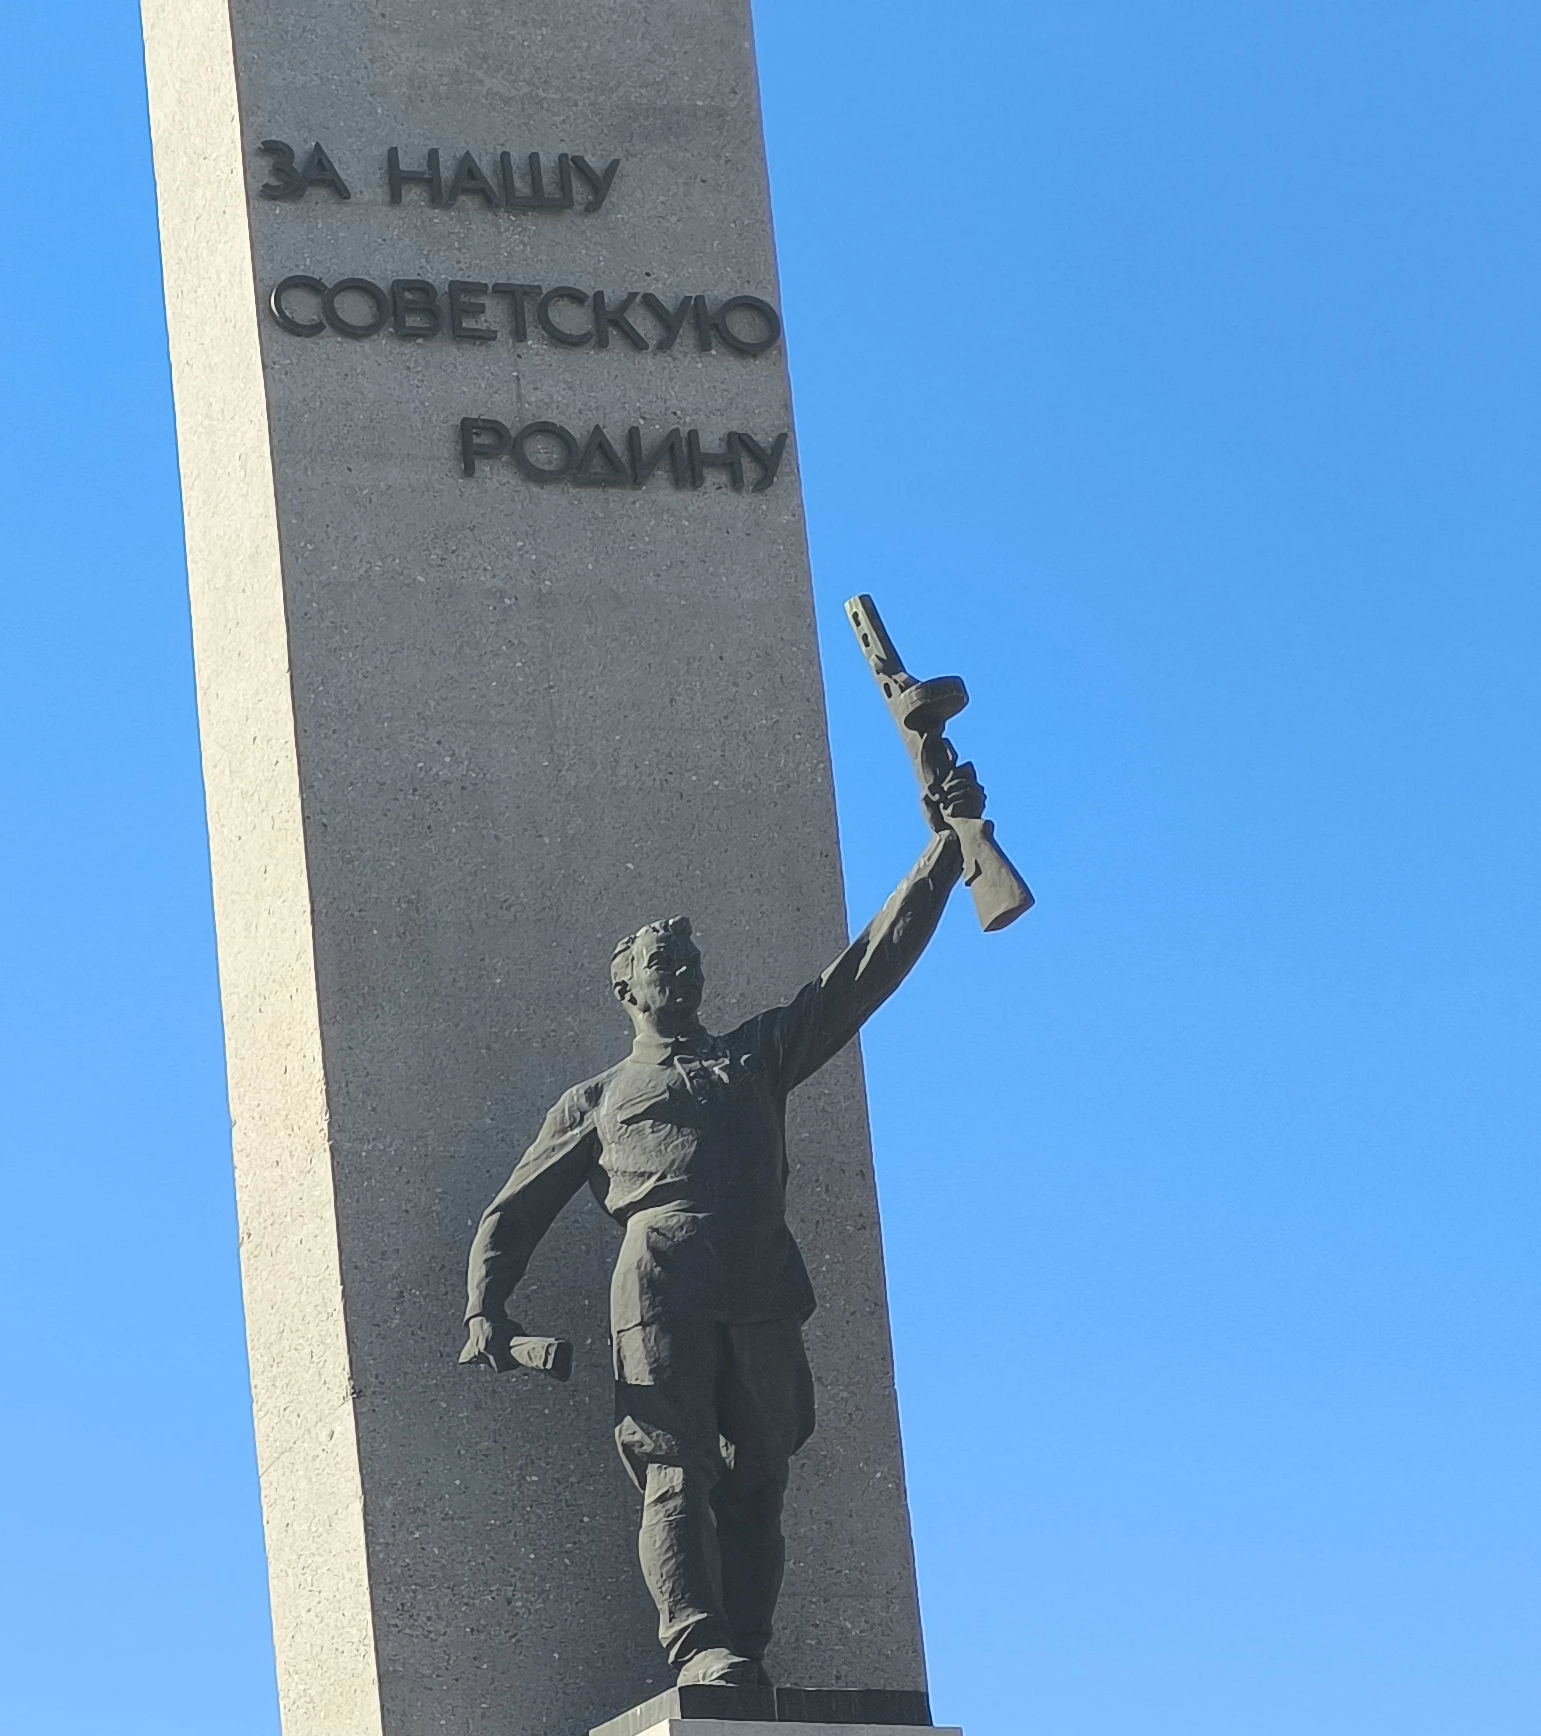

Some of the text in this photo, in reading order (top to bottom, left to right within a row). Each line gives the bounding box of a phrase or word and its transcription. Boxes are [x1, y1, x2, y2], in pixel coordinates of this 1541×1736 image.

[256, 139, 622, 212] ЗА НАШУ
[270, 275, 782, 355] СОВЕТСКУЮ
[458, 417, 788, 493] РОДИНУ
